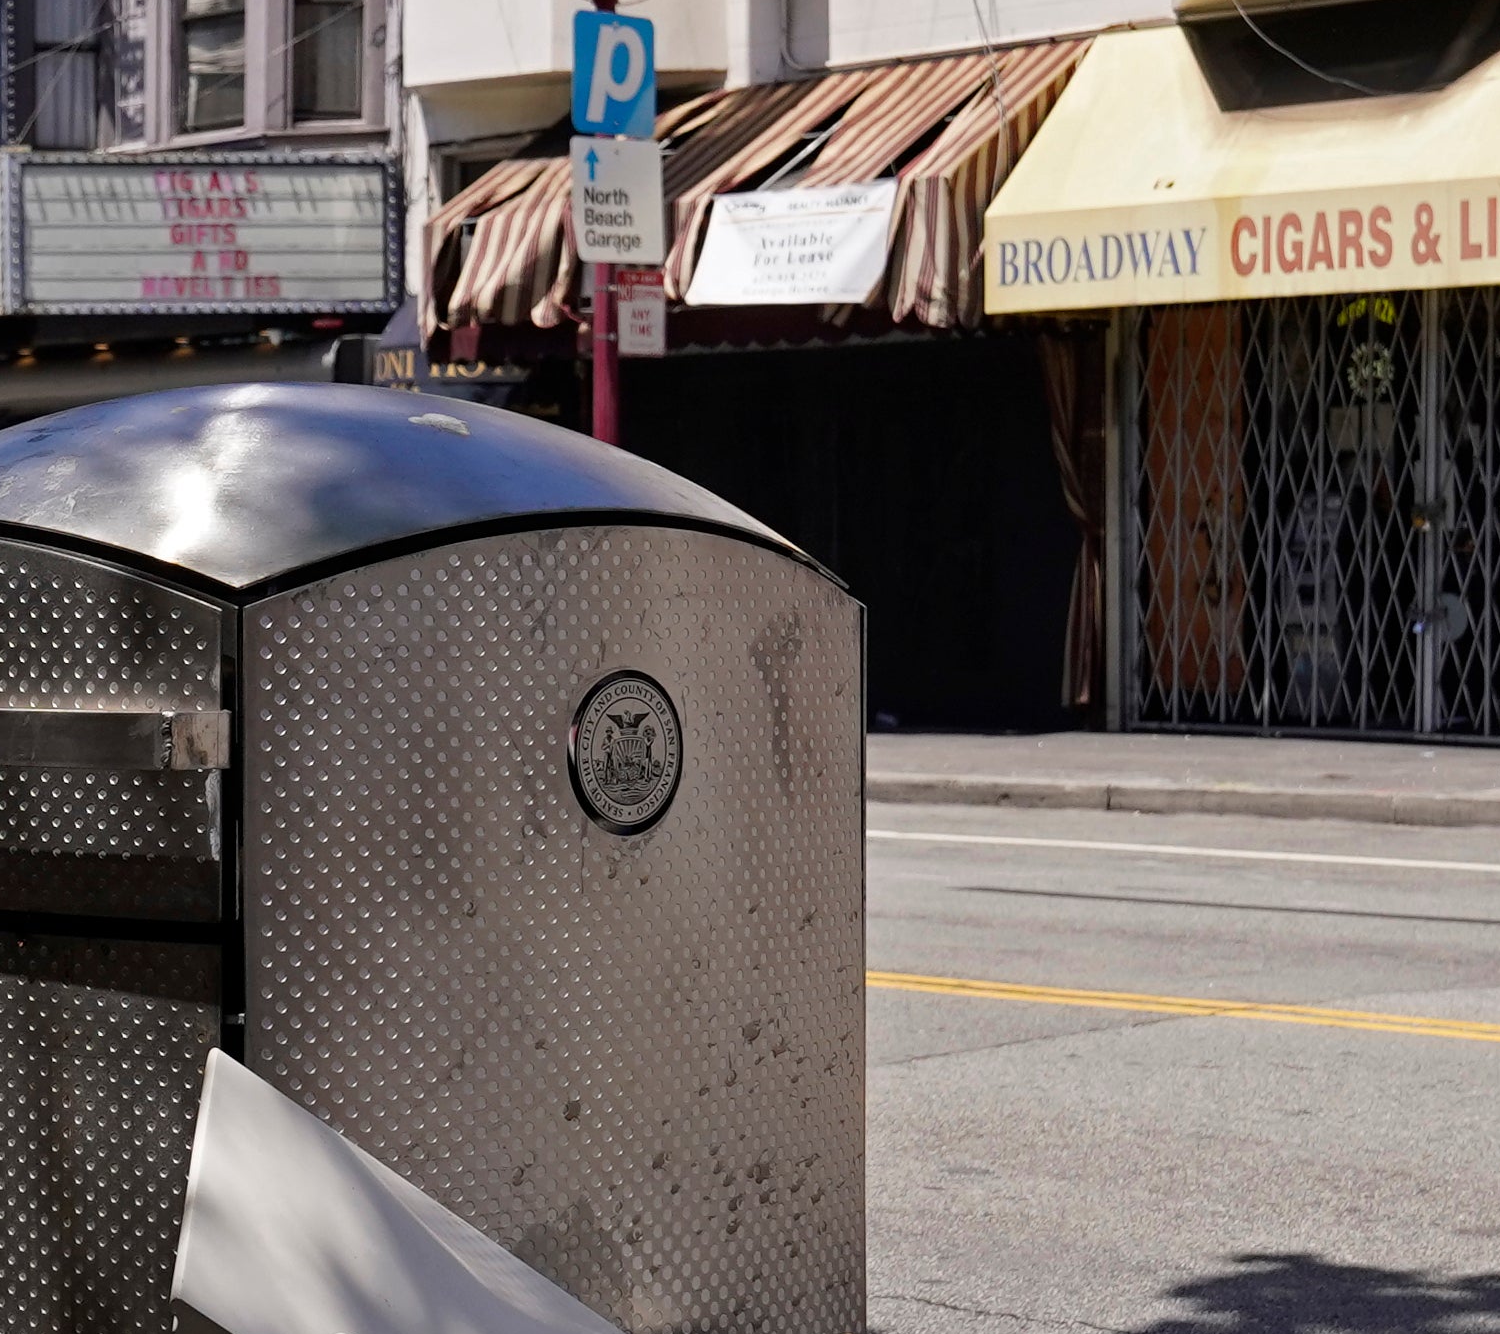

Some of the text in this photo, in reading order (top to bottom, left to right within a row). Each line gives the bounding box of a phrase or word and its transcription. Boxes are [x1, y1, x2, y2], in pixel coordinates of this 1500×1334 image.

[583, 186, 630, 206] North
[583, 208, 634, 227] Beach
[169, 223, 238, 245] GIFTS
[584, 229, 642, 252] Garage
[761, 232, 834, 250] Available
[999, 226, 1207, 287] BROADWAY
[1231, 205, 1394, 277] CIGARS
[1411, 202, 1442, 266] &
[754, 249, 835, 267] For Lease
[631, 308, 650, 321] ANY
[630, 324, 652, 337] TIME
[582, 685, 676, 817] SEAL OF THE CITY AND COUNTY OF SAN FRANCISCO
